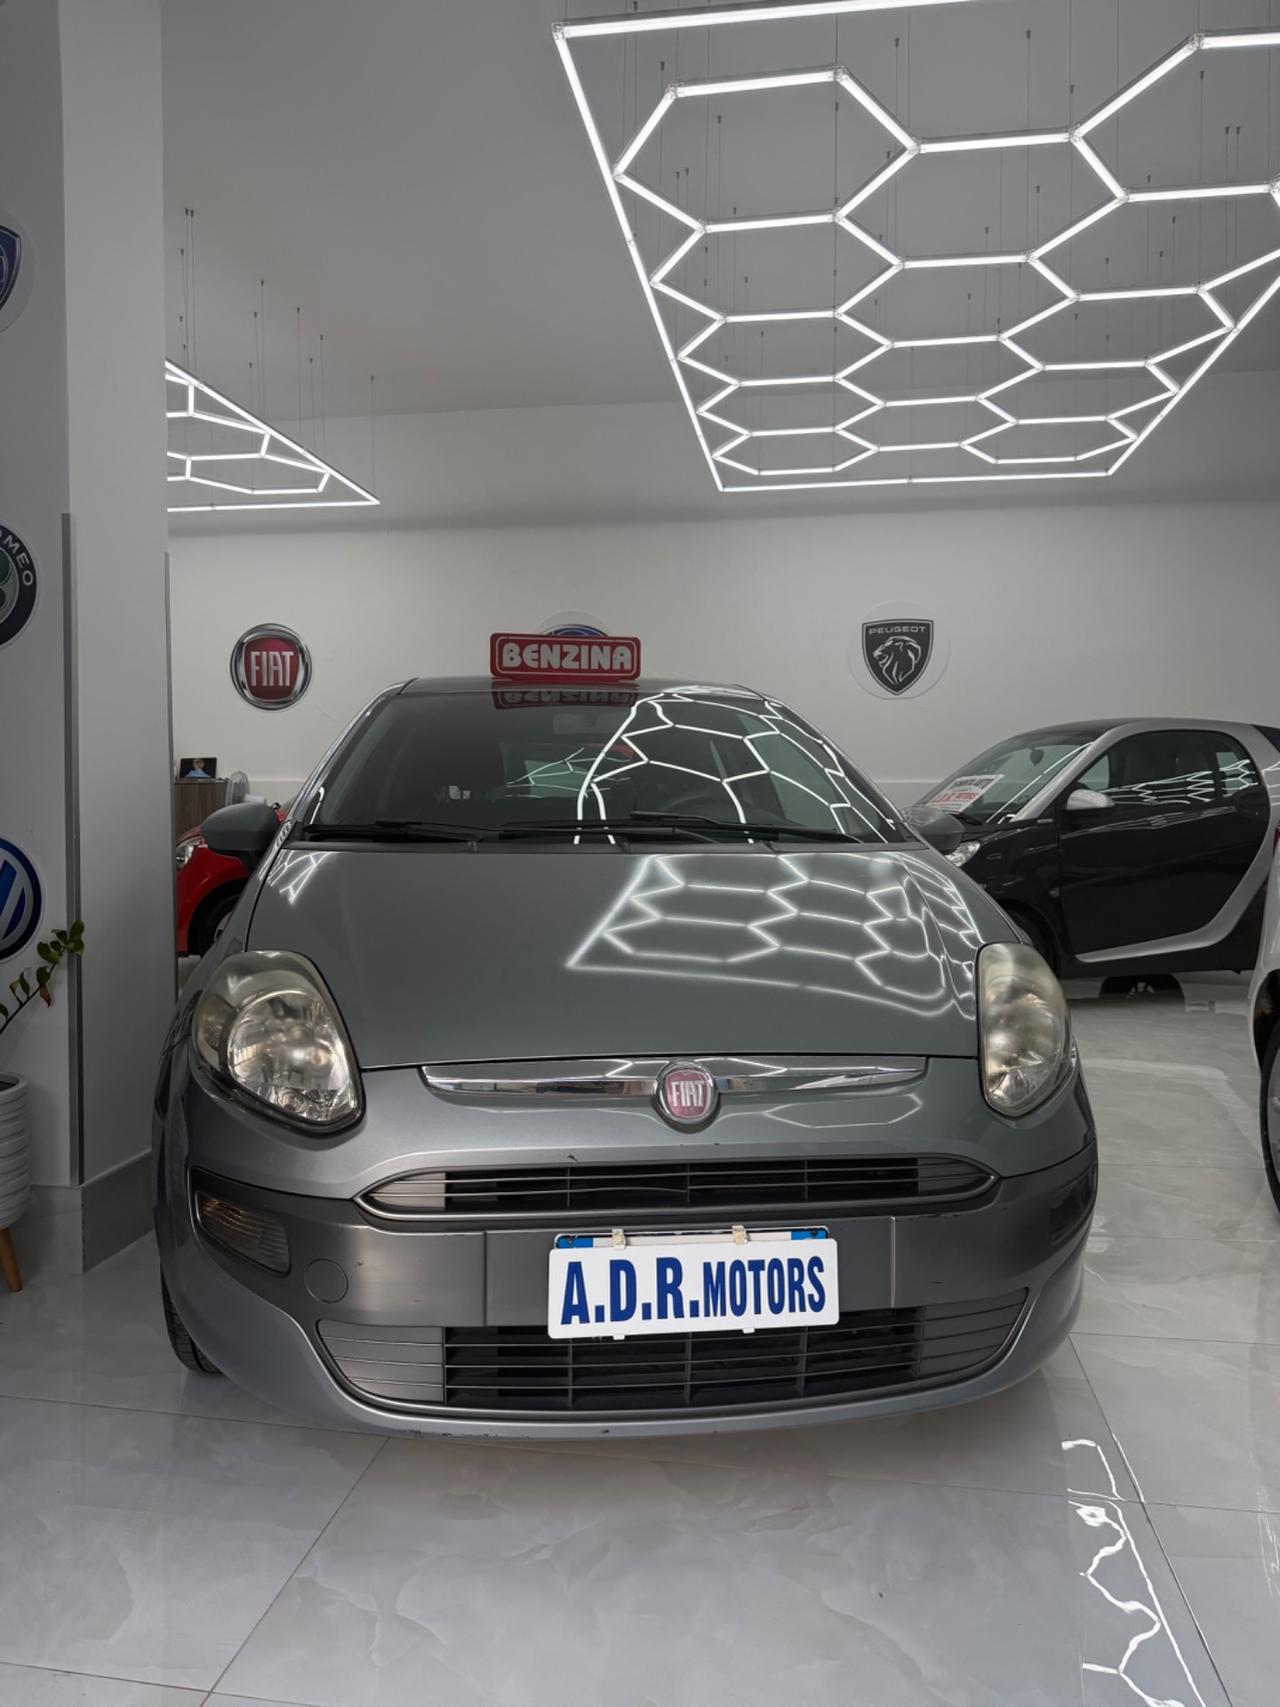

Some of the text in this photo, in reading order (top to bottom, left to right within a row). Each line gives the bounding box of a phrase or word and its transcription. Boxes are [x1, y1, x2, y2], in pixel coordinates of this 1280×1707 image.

[0, 530, 33, 586] MEO
[869, 626, 927, 635] PEUGEOT
[250, 651, 295, 687] FIAT
[502, 642, 632, 670] BENZINA
[671, 1080, 706, 1107] FIAT
